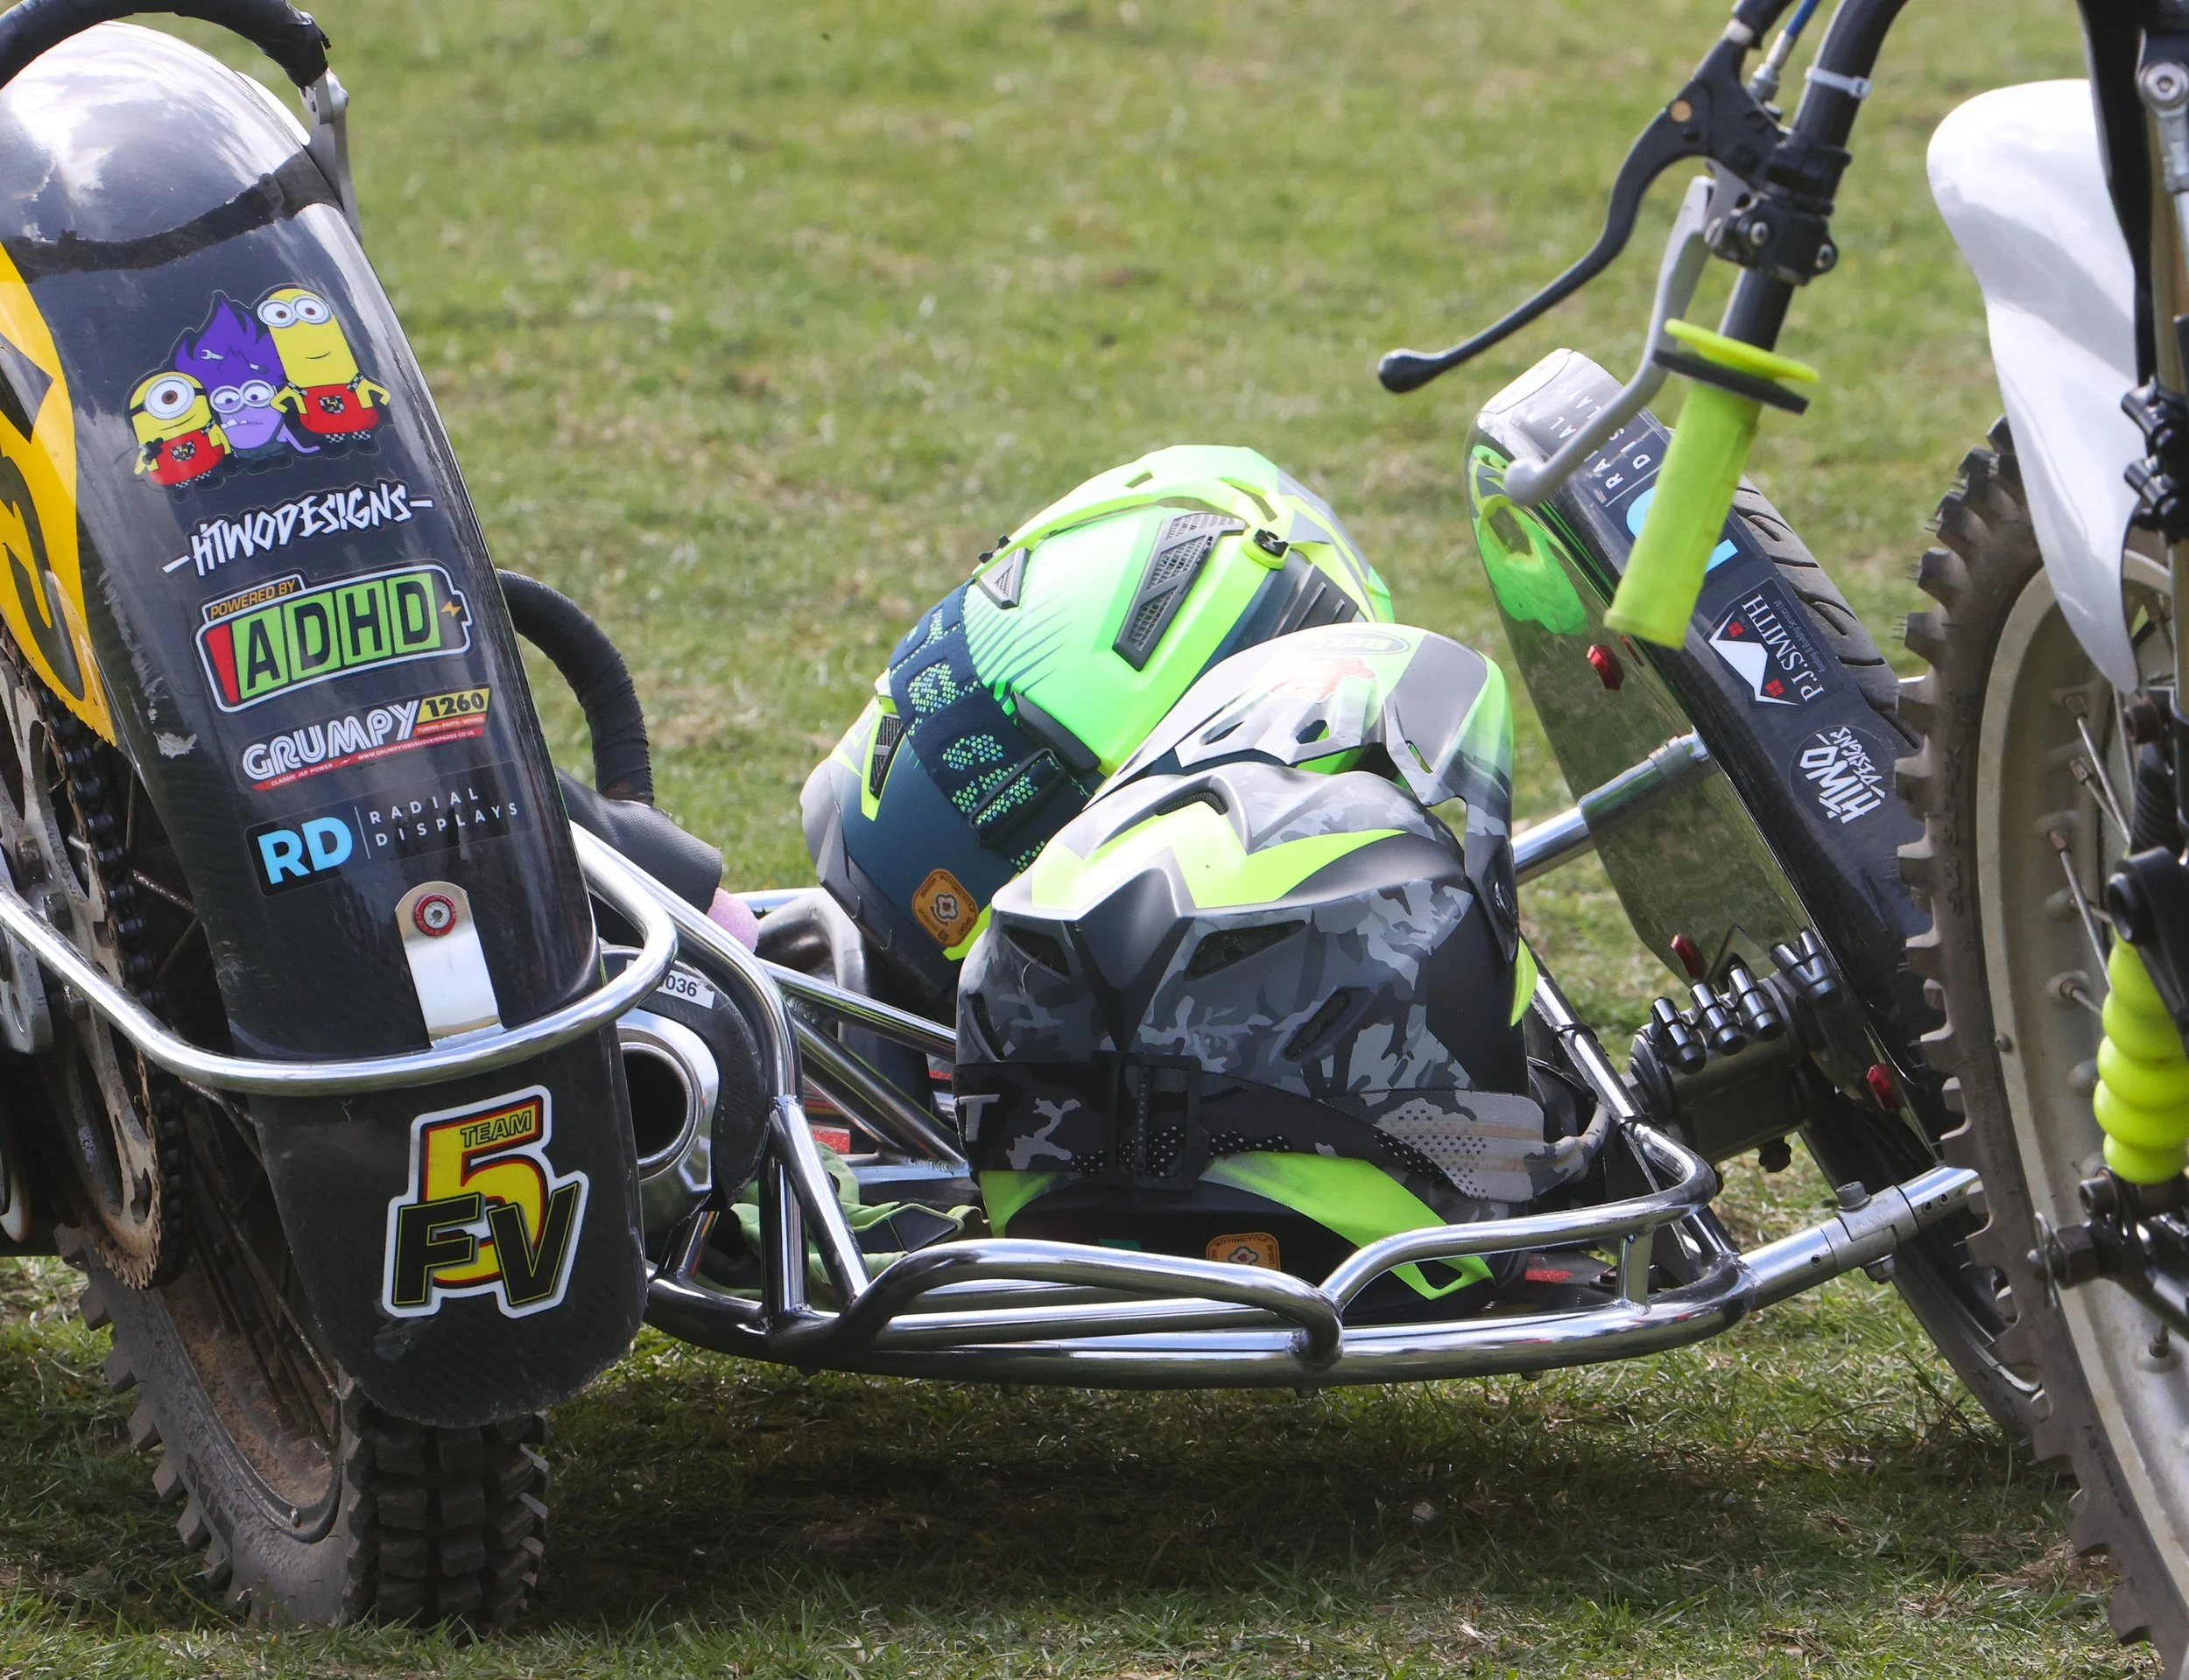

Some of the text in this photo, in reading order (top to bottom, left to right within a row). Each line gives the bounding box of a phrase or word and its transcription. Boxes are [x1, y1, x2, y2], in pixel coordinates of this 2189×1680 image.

[210, 579, 296, 620] POWERED BY
[246, 580, 431, 691] ADHD
[243, 692, 484, 780] GRUMPY 1260
[271, 774, 297, 786] CLASSIC
[309, 763, 333, 773] POWER
[369, 787, 478, 825] RADIAL
[375, 802, 517, 847] DISPLAYS
[257, 816, 353, 884] RD
[460, 1109, 532, 1149] TEAM
[419, 1094, 550, 1290] 5
[391, 1181, 581, 1308] FV
[1214, 1234, 1269, 1248] MOTORCYCLE
